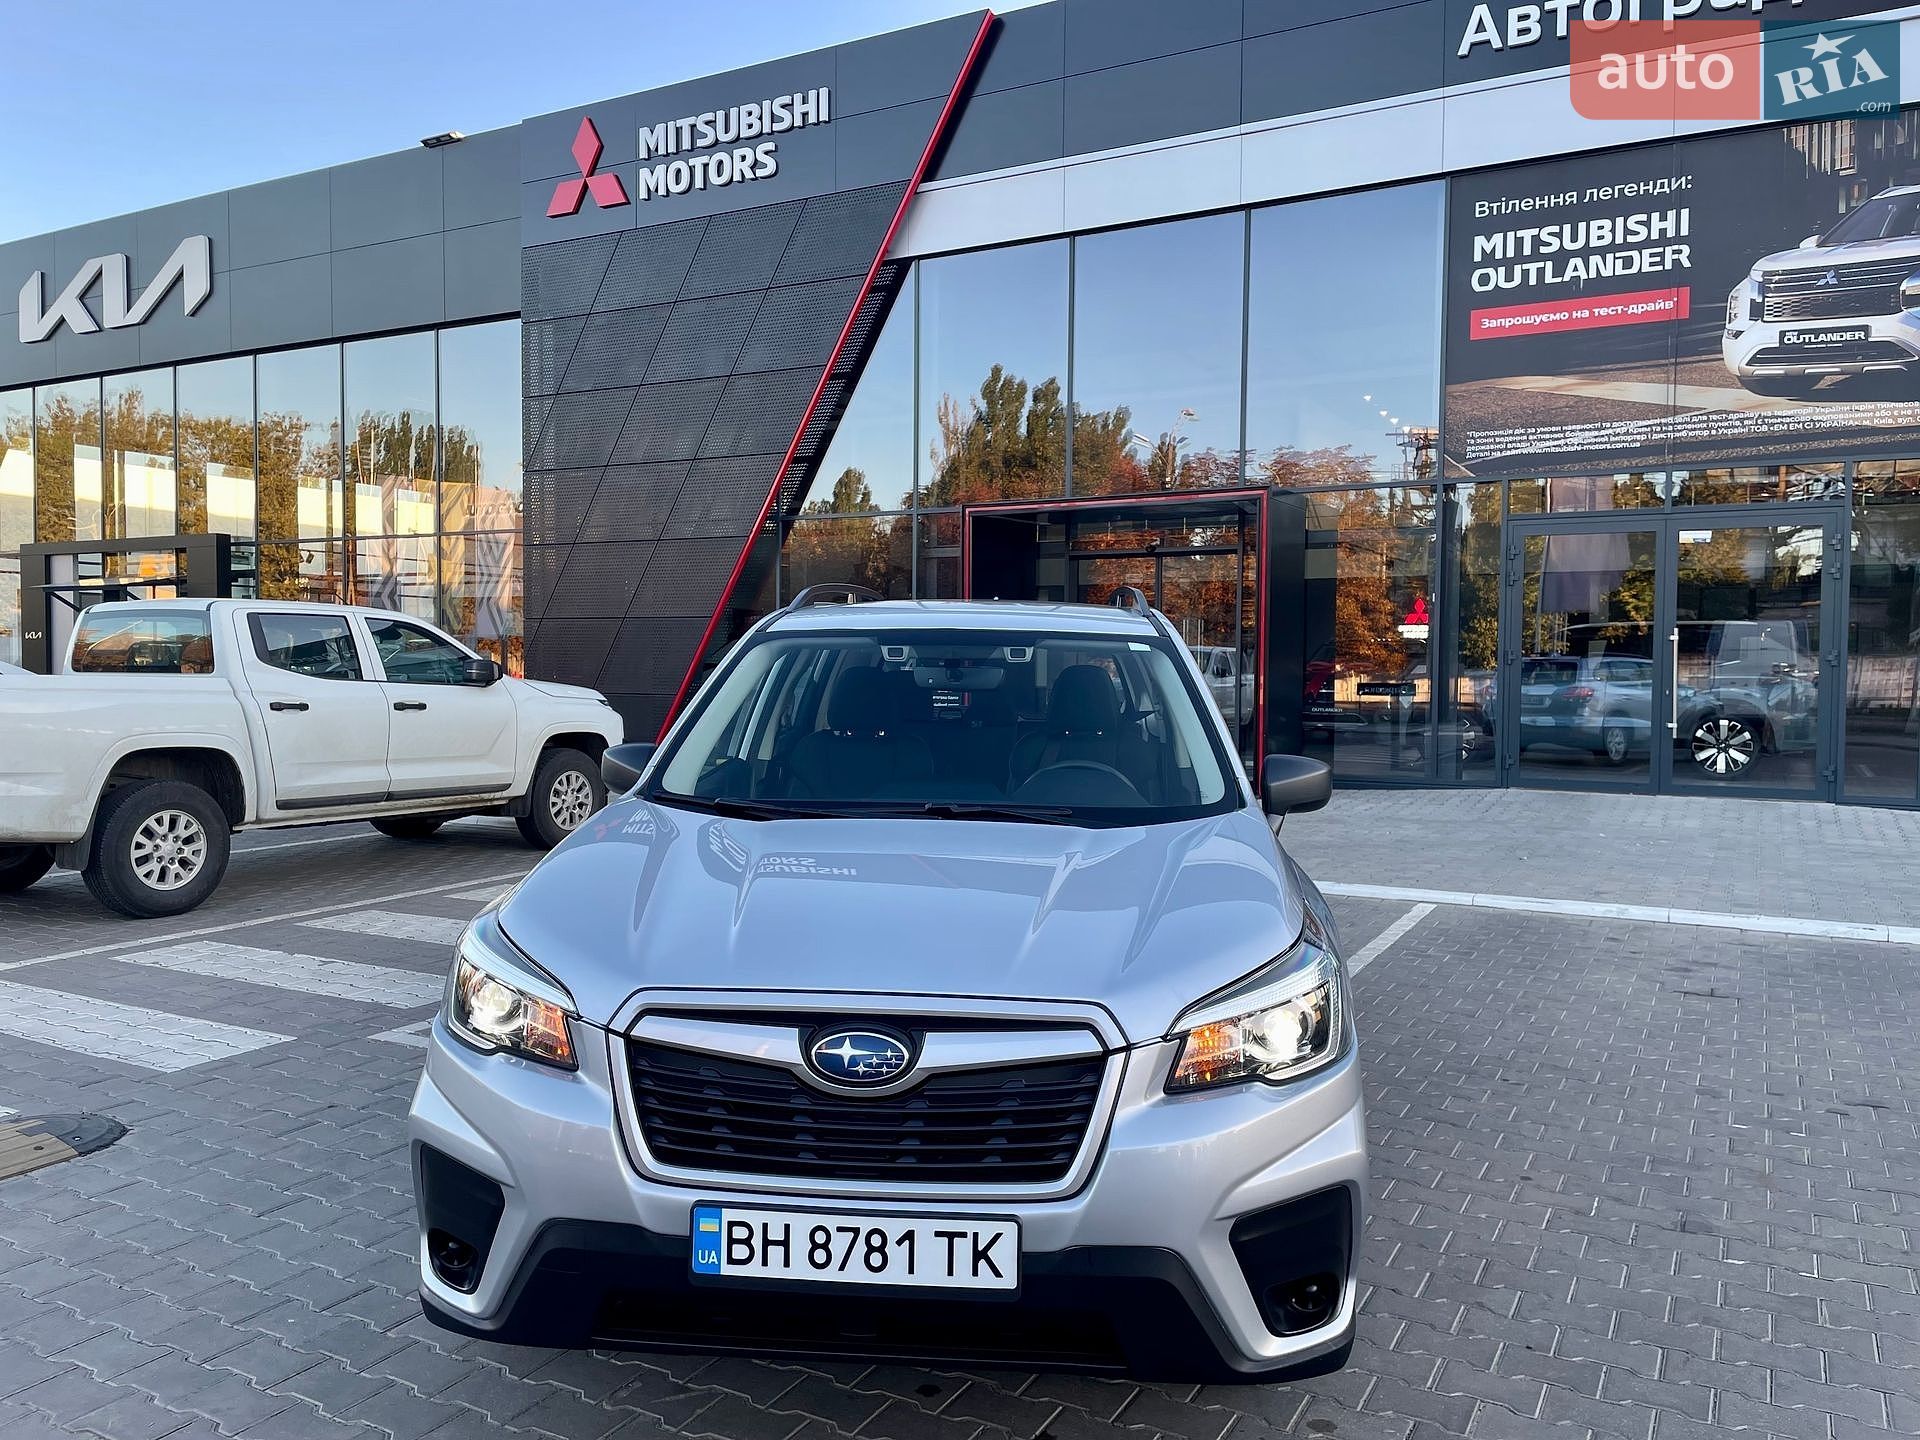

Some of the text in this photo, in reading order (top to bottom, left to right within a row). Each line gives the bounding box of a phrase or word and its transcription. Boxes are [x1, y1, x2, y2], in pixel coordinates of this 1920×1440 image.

[638, 87, 830, 160] MITSUBISHI
[638, 141, 778, 200] MOTORS
[1475, 174, 1693, 218] Втілення легенди:
[1473, 207, 1690, 262] MITSUBISHI
[1471, 244, 1692, 293] OUTLANDER
[1480, 307, 1569, 329] Запрошуємо
[1573, 308, 1589, 319] на
[1783, 331, 1866, 344] OUTLANDER
[1815, 404, 1850, 414] України
[1749, 425, 1768, 433] ТОВ
[1465, 451, 1490, 459] Деталі
[698, 1249, 719, 1265] UA
[725, 1220, 1005, 1280] BH 8781 TK
